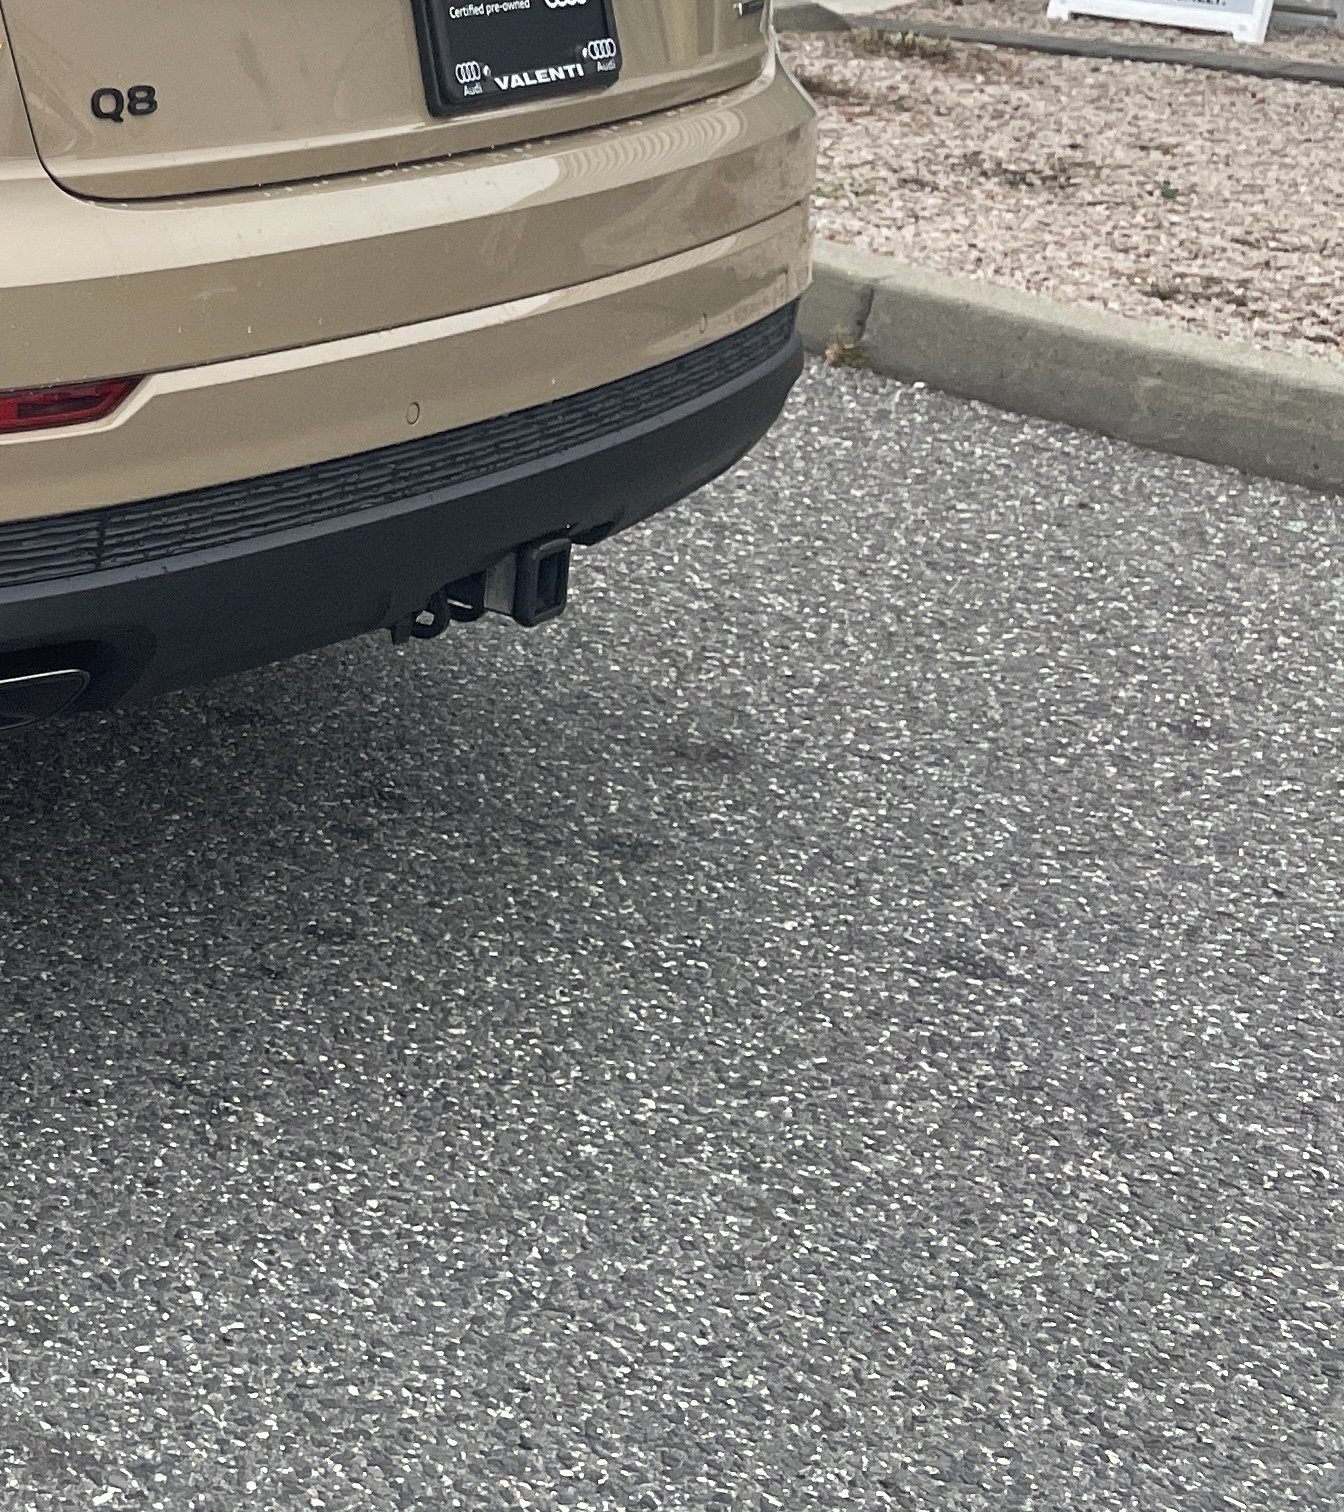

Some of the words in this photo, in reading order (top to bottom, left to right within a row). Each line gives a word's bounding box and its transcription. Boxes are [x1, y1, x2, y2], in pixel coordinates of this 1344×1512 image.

[449, 3, 485, 19] Certified
[597, 60, 616, 73] Audi
[494, 63, 584, 90] VALENTI
[464, 82, 483, 97] Audi
[91, 85, 158, 123] Q8
